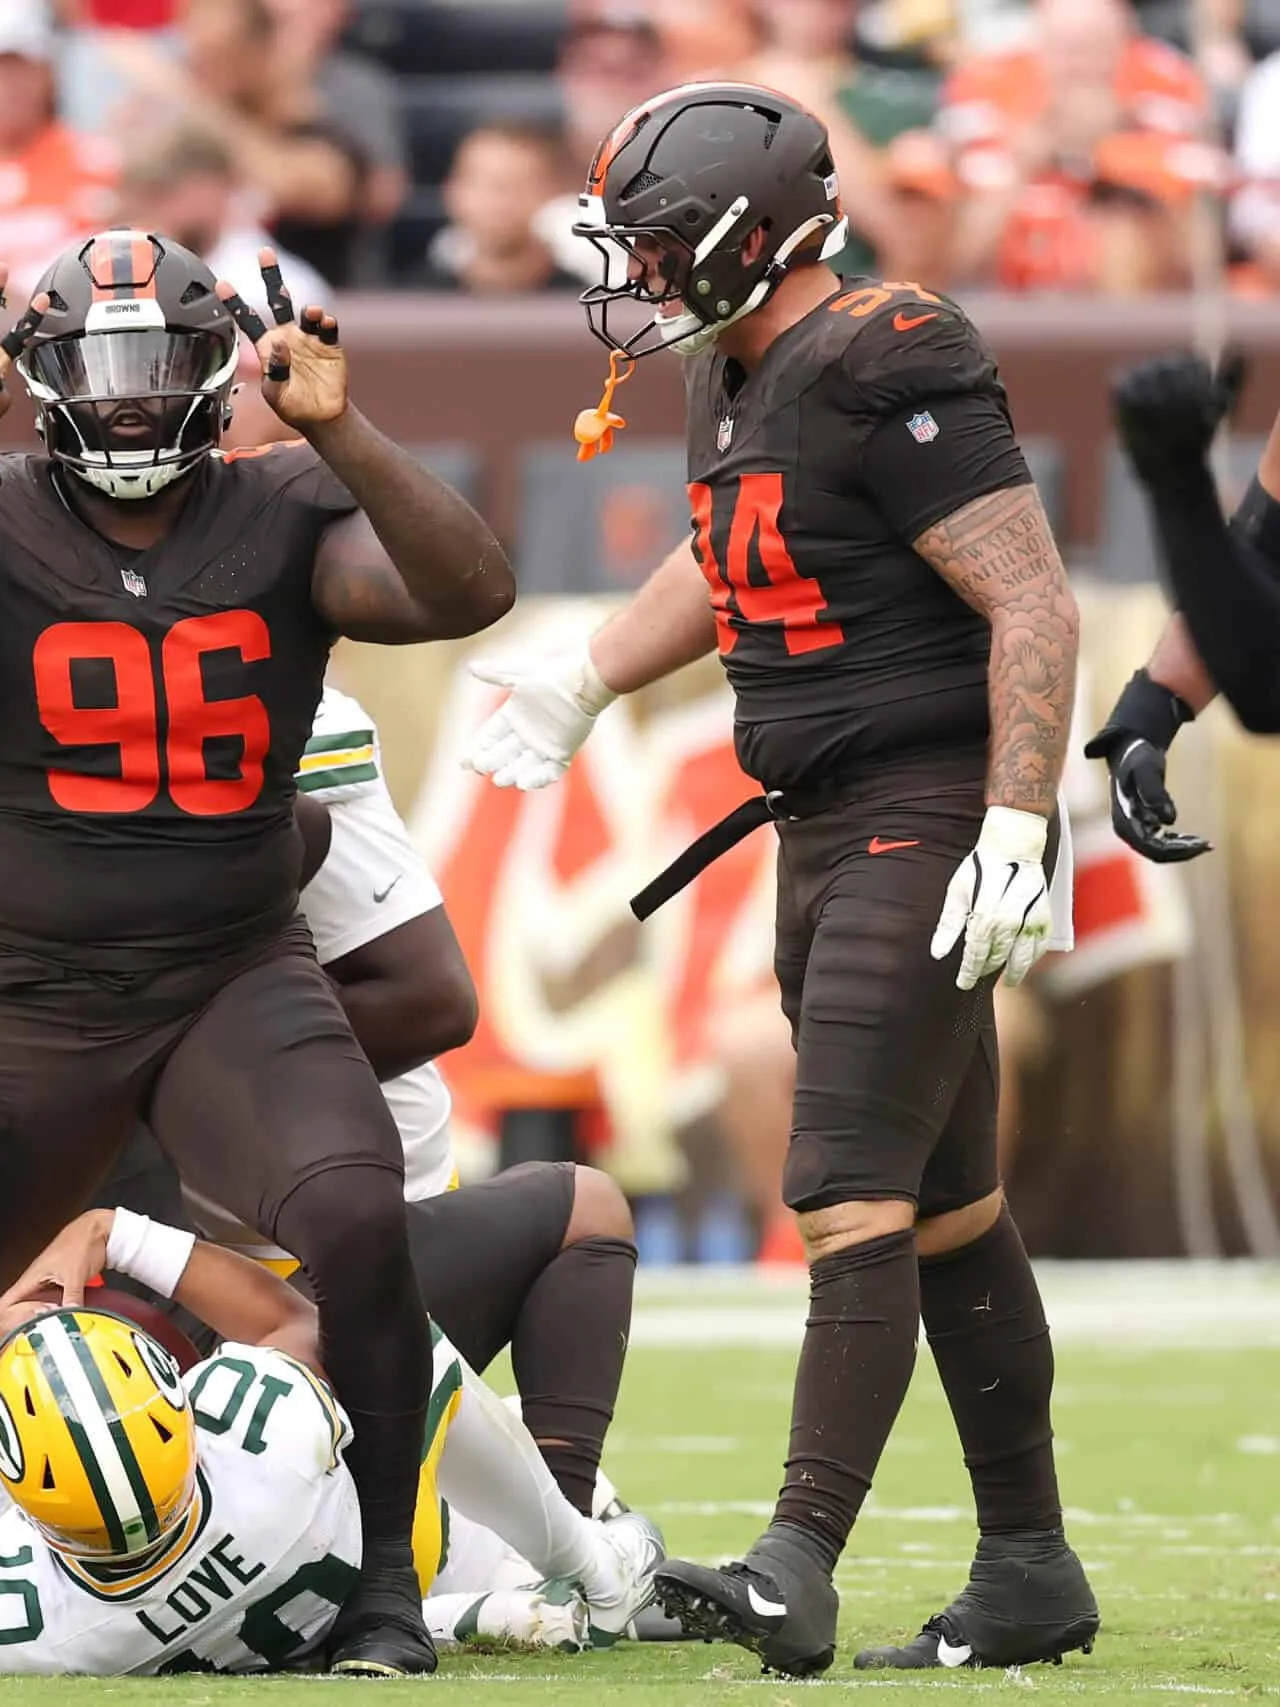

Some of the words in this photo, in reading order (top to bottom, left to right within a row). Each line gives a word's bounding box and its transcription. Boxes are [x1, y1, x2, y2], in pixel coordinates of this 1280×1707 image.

[105, 303, 140, 314] BROWNS
[33, 609, 271, 816] 96
[191, 1357, 295, 1455] 10
[136, 1533, 266, 1645] LOVE
